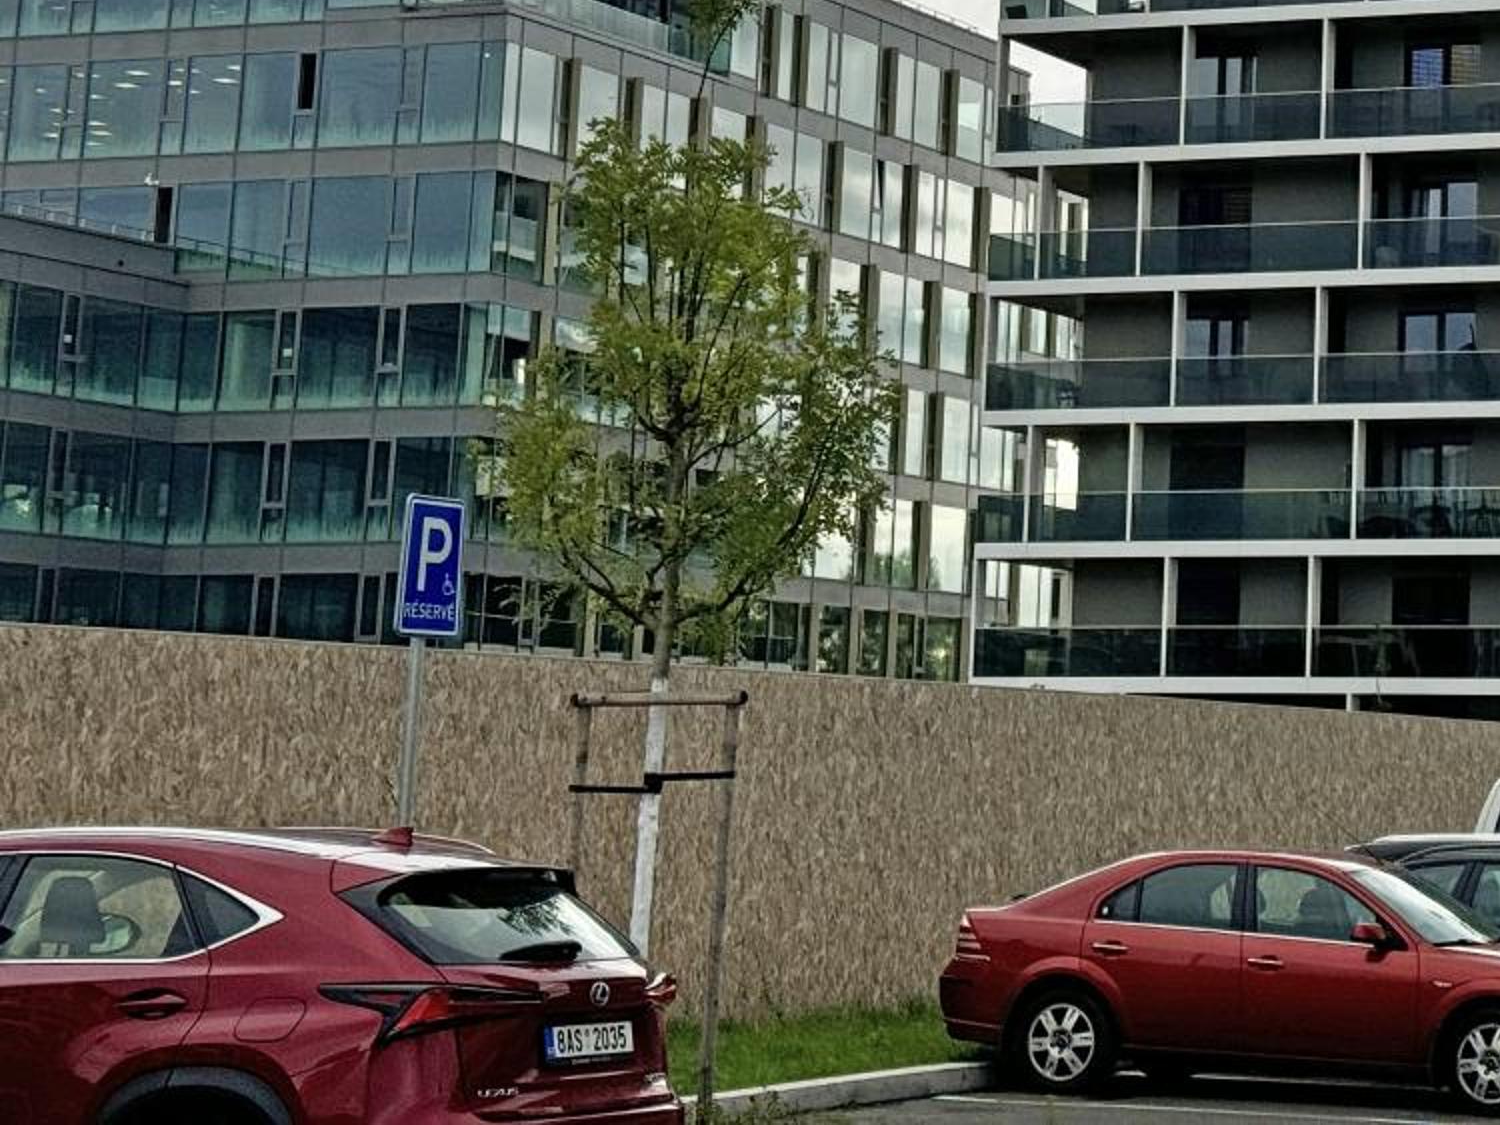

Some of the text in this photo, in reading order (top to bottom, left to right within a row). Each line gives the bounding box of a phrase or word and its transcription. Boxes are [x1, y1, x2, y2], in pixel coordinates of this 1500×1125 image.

[417, 516, 453, 593] P
[557, 1024, 627, 1053] 8AS 2035
